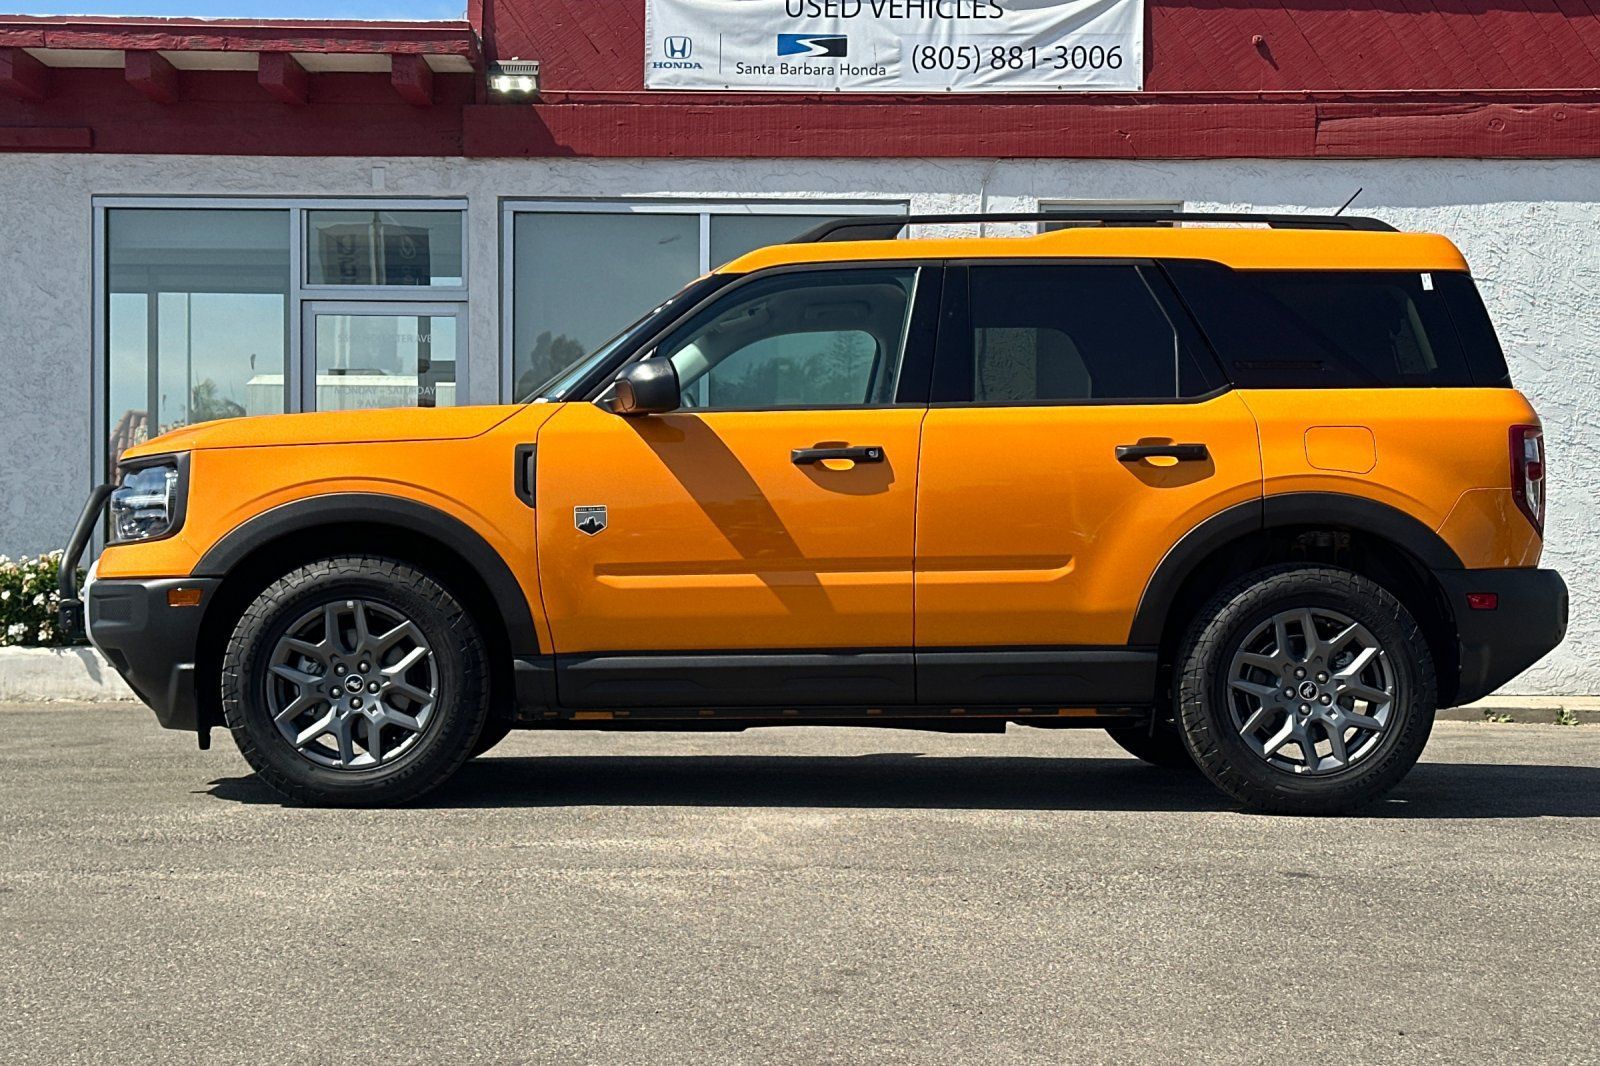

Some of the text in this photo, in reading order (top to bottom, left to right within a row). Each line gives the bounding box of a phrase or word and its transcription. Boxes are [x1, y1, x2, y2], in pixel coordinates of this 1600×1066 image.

[786, 0, 1004, 19] USED VEHICLES
[652, 61, 703, 69] HONDA
[912, 44, 1123, 74] (805) 881-3006
[736, 62, 886, 76] Santa Barbara Honda
